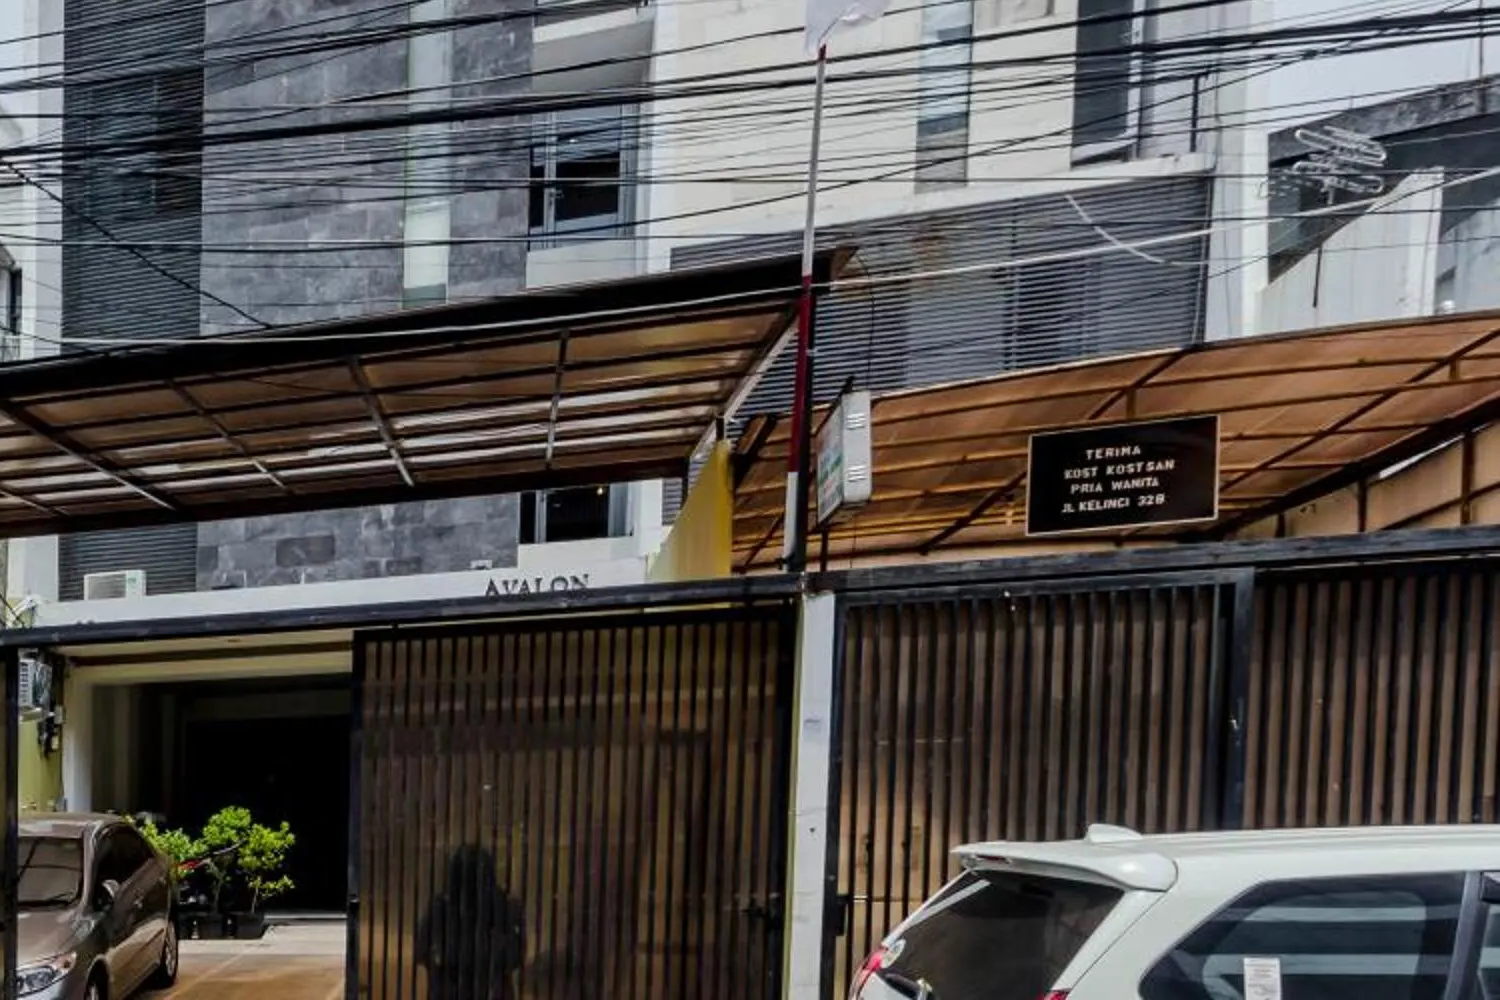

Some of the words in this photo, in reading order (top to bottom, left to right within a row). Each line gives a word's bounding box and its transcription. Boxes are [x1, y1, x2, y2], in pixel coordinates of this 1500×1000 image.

[1086, 445, 1141, 460] TERIMA
[1064, 466, 1098, 479] KOST
[1070, 482, 1103, 494] PRIA
[1111, 477, 1159, 491] WANITA
[1079, 497, 1130, 512] KELINCI
[485, 574, 590, 597] AVALON
